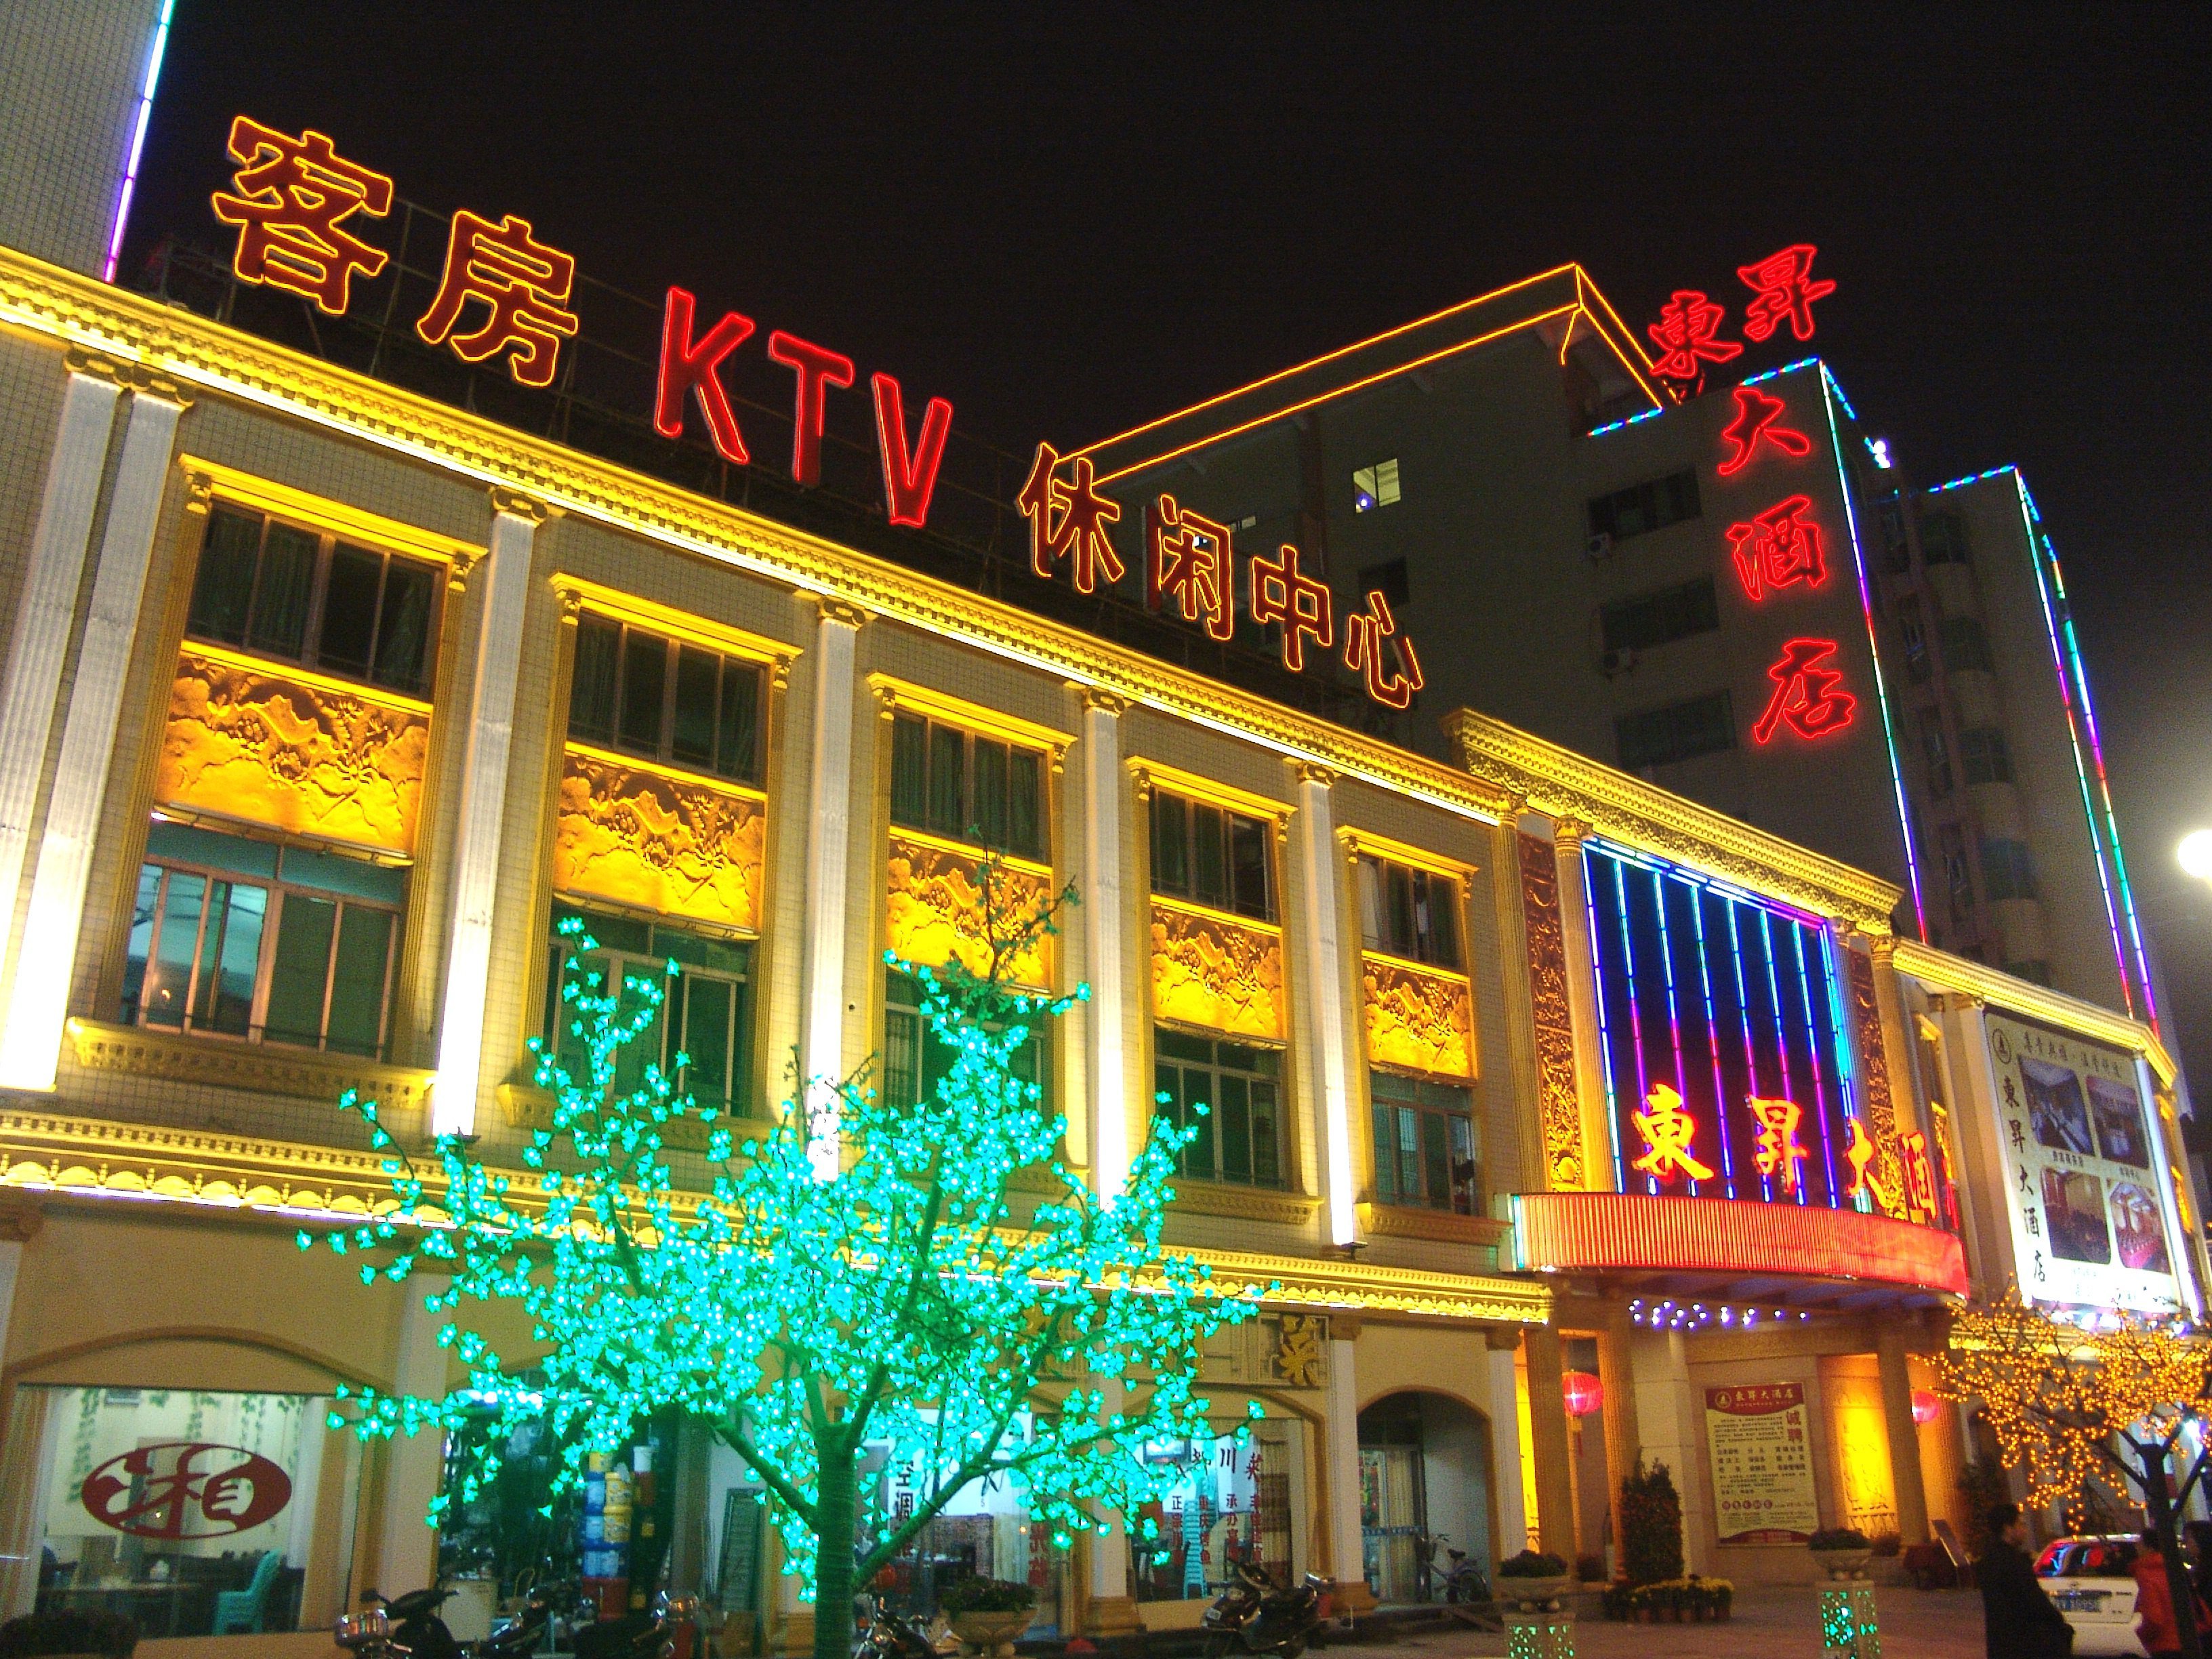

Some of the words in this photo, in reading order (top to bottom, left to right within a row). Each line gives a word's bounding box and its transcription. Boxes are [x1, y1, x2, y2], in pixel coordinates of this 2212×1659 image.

[211, 114, 579, 387] 客房
[653, 285, 954, 527] KTV
[1017, 441, 1426, 710] 休闲中心
[1718, 386, 1856, 745] 大酒店
